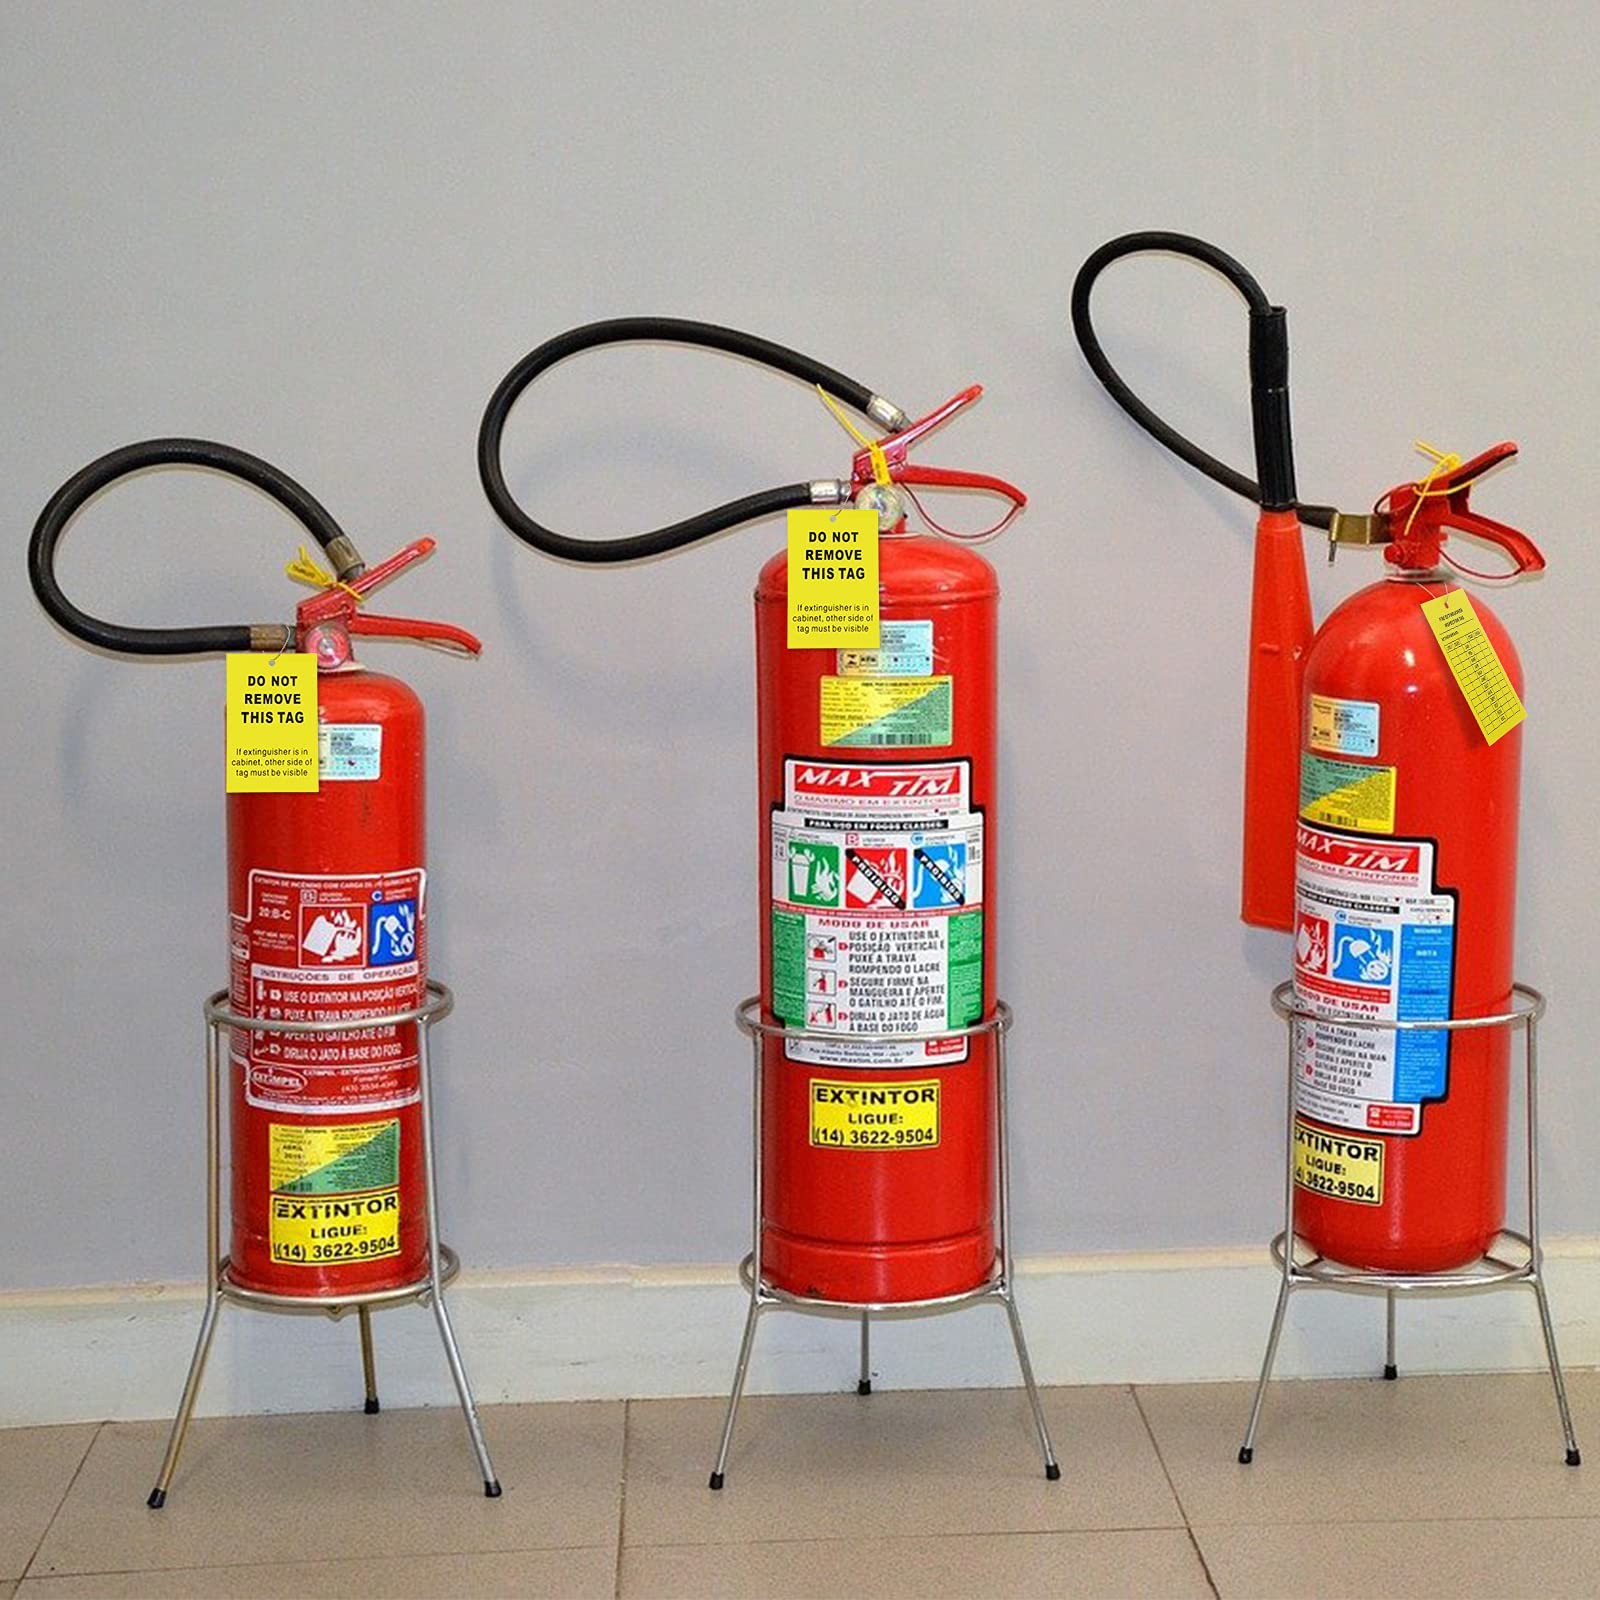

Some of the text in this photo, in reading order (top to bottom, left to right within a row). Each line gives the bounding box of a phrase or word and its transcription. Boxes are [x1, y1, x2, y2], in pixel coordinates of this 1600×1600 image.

[809, 532, 858, 542] DO NOT
[806, 550, 862, 560] REMOVE
[802, 567, 865, 580] THIS TAG
[797, 604, 870, 613] If extinguisher is in
[792, 614, 874, 622] cabinet, other side of
[797, 625, 810, 634] tag
[248, 676, 298, 686] DO NOT
[244, 694, 301, 704] REMOVE
[241, 712, 304, 724] THIS TAG
[236, 748, 308, 757] If extinguisher is in
[231, 758, 313, 766] cabinet, other side of
[236, 769, 248, 778] tag
[797, 768, 954, 796] MAX TIM
[1296, 829, 1331, 854] MAX
[1344, 850, 1409, 871] TIM
[852, 856, 900, 903] PROIBIDO
[818, 918, 929, 929] MODO DE USAR
[849, 930, 940, 941] USE O EXTINTOR NA
[895, 941, 938, 952] VERTICAL
[849, 953, 916, 963] PUXE A TRAVA
[260, 969, 330, 982] INSTRUÇÕES
[363, 966, 413, 980] OPERAÇÃO
[849, 962, 940, 974] ROMPENDO O LACRE
[849, 976, 929, 986] SEGURE FIRME NA
[284, 986, 393, 1004] USE O EXTINTOR NA POSIÇÃO
[849, 987, 904, 998] MANGUEIRA
[914, 984, 944, 996] APERTE
[849, 998, 856, 1007] O
[858, 998, 898, 1008] GATILHO
[918, 997, 925, 1006] O
[1323, 996, 1336, 1006] DE
[1341, 1000, 1380, 1013] USAR
[284, 1008, 305, 1021] PUXE
[306, 1010, 313, 1022] A
[314, 1010, 341, 1022] TRAVA
[880, 1011, 886, 1022] O
[888, 1011, 910, 1022] JATO
[912, 1010, 922, 1020] DE
[857, 1022, 918, 1032] BASE DO FOGO
[316, 1032, 324, 1042] O
[284, 1046, 310, 1060] DIRIJA
[310, 1048, 318, 1060] O
[318, 1048, 340, 1060] JATO
[348, 1046, 370, 1060] BASE
[370, 1045, 382, 1058] DO
[383, 1042, 402, 1056] FOGO
[816, 1088, 935, 1106] EXTINTOR
[848, 1113, 903, 1125] LIGUE:
[815, 1127, 933, 1145] (14) 3622-9504
[1306, 1154, 1346, 1176] LIGUE:
[1306, 1171, 1374, 1198] 3622-9504
[277, 1196, 397, 1220] EXTINTOR
[310, 1225, 367, 1239] LIGUE:
[313, 1235, 395, 1258] 3622-9504
